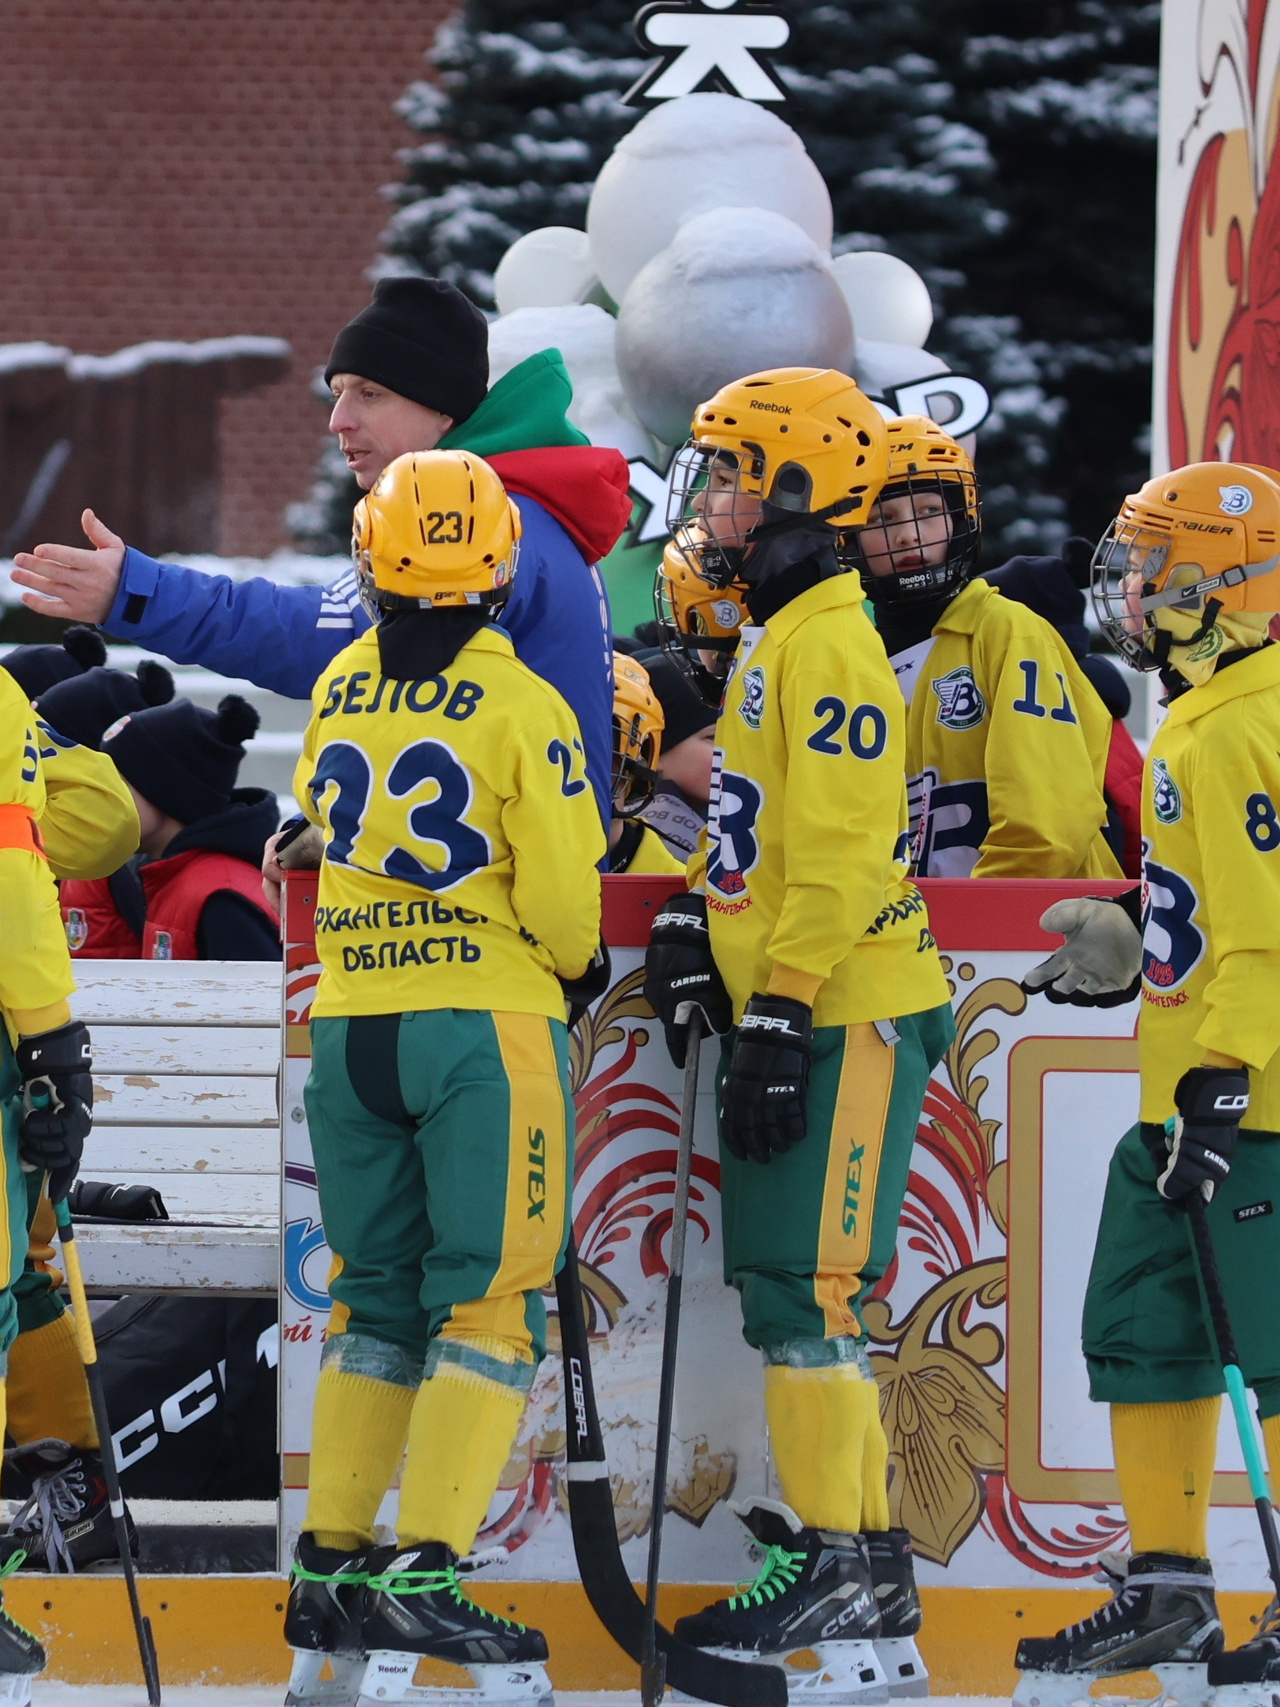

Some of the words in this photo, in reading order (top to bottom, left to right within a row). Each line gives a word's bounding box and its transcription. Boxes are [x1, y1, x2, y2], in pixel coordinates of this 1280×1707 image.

[749, 399, 793, 416] Reebok
[426, 510, 464, 545] 23
[319, 671, 484, 721] БЕЛОВ
[1012, 660, 1078, 726] 11
[807, 695, 888, 760] 20
[1245, 791, 1280, 852] 8
[342, 935, 482, 973] ОБЛАСТЬ
[1146, 957, 1175, 985] 1925
[671, 973, 711, 989] CARBON
[528, 1125, 546, 1224] STEX
[1204, 1149, 1231, 1174] CARBON
[841, 1138, 866, 1240] STEX
[1238, 1204, 1266, 1219] STEX
[112, 1358, 229, 1474] CC
[569, 1357, 590, 1456] COBRA
[821, 1591, 870, 1638] CCM
[378, 1664, 409, 1675] Reebok
